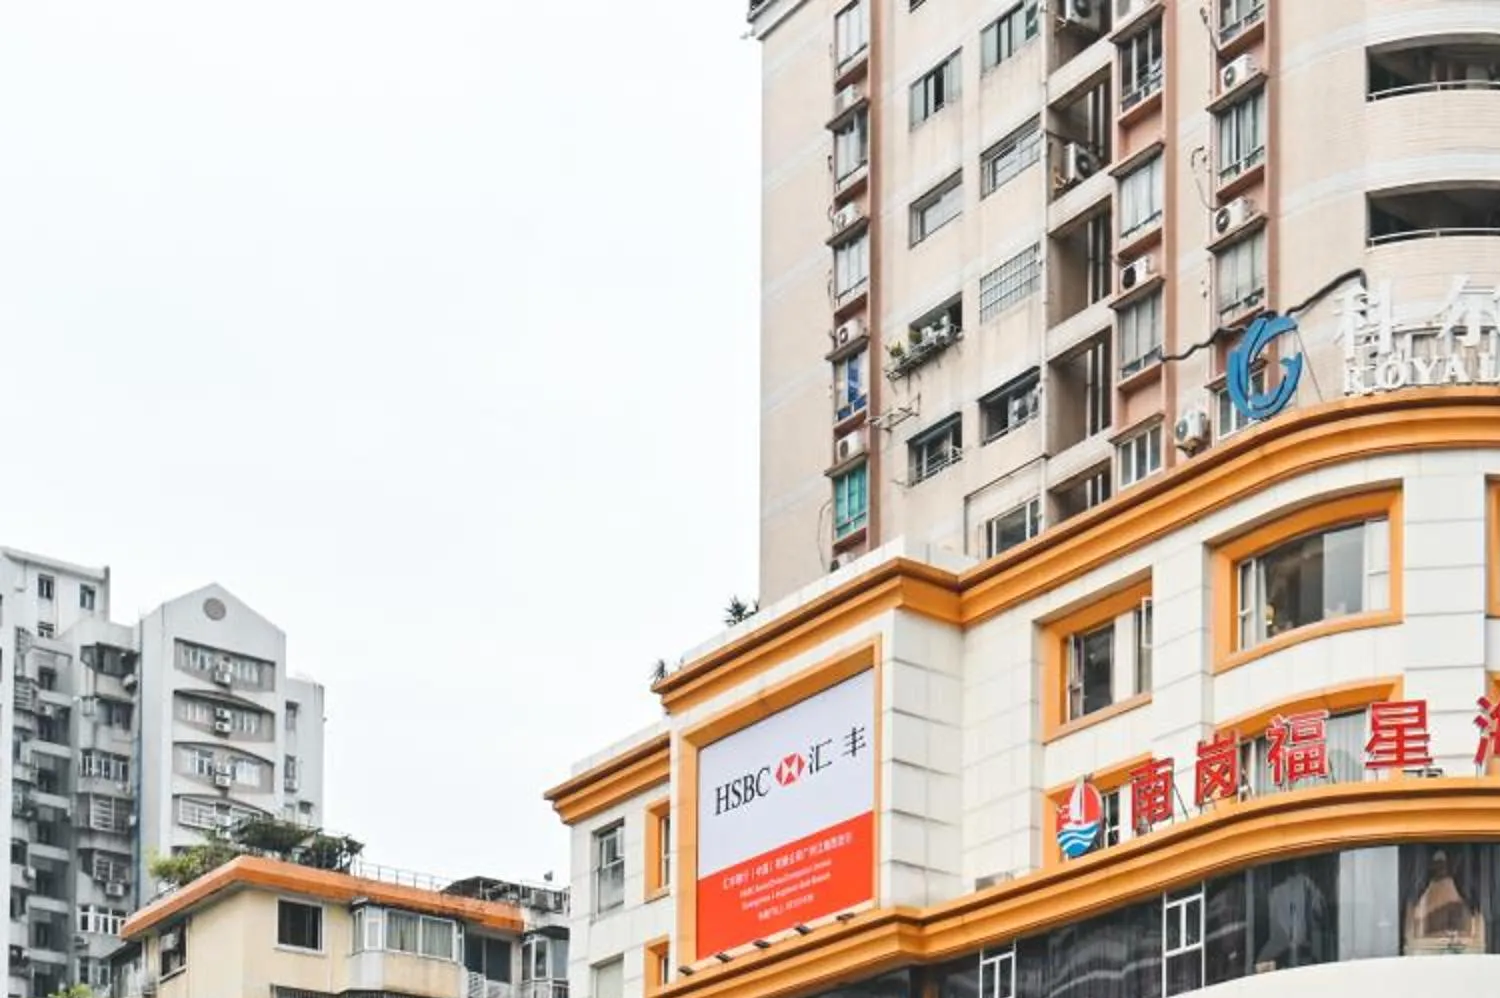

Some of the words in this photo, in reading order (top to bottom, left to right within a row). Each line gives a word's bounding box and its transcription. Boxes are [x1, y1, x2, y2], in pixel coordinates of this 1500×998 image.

[1343, 352, 1500, 396] ROYAL
[809, 727, 867, 775] 汇丰
[714, 767, 771, 816] HSBC
